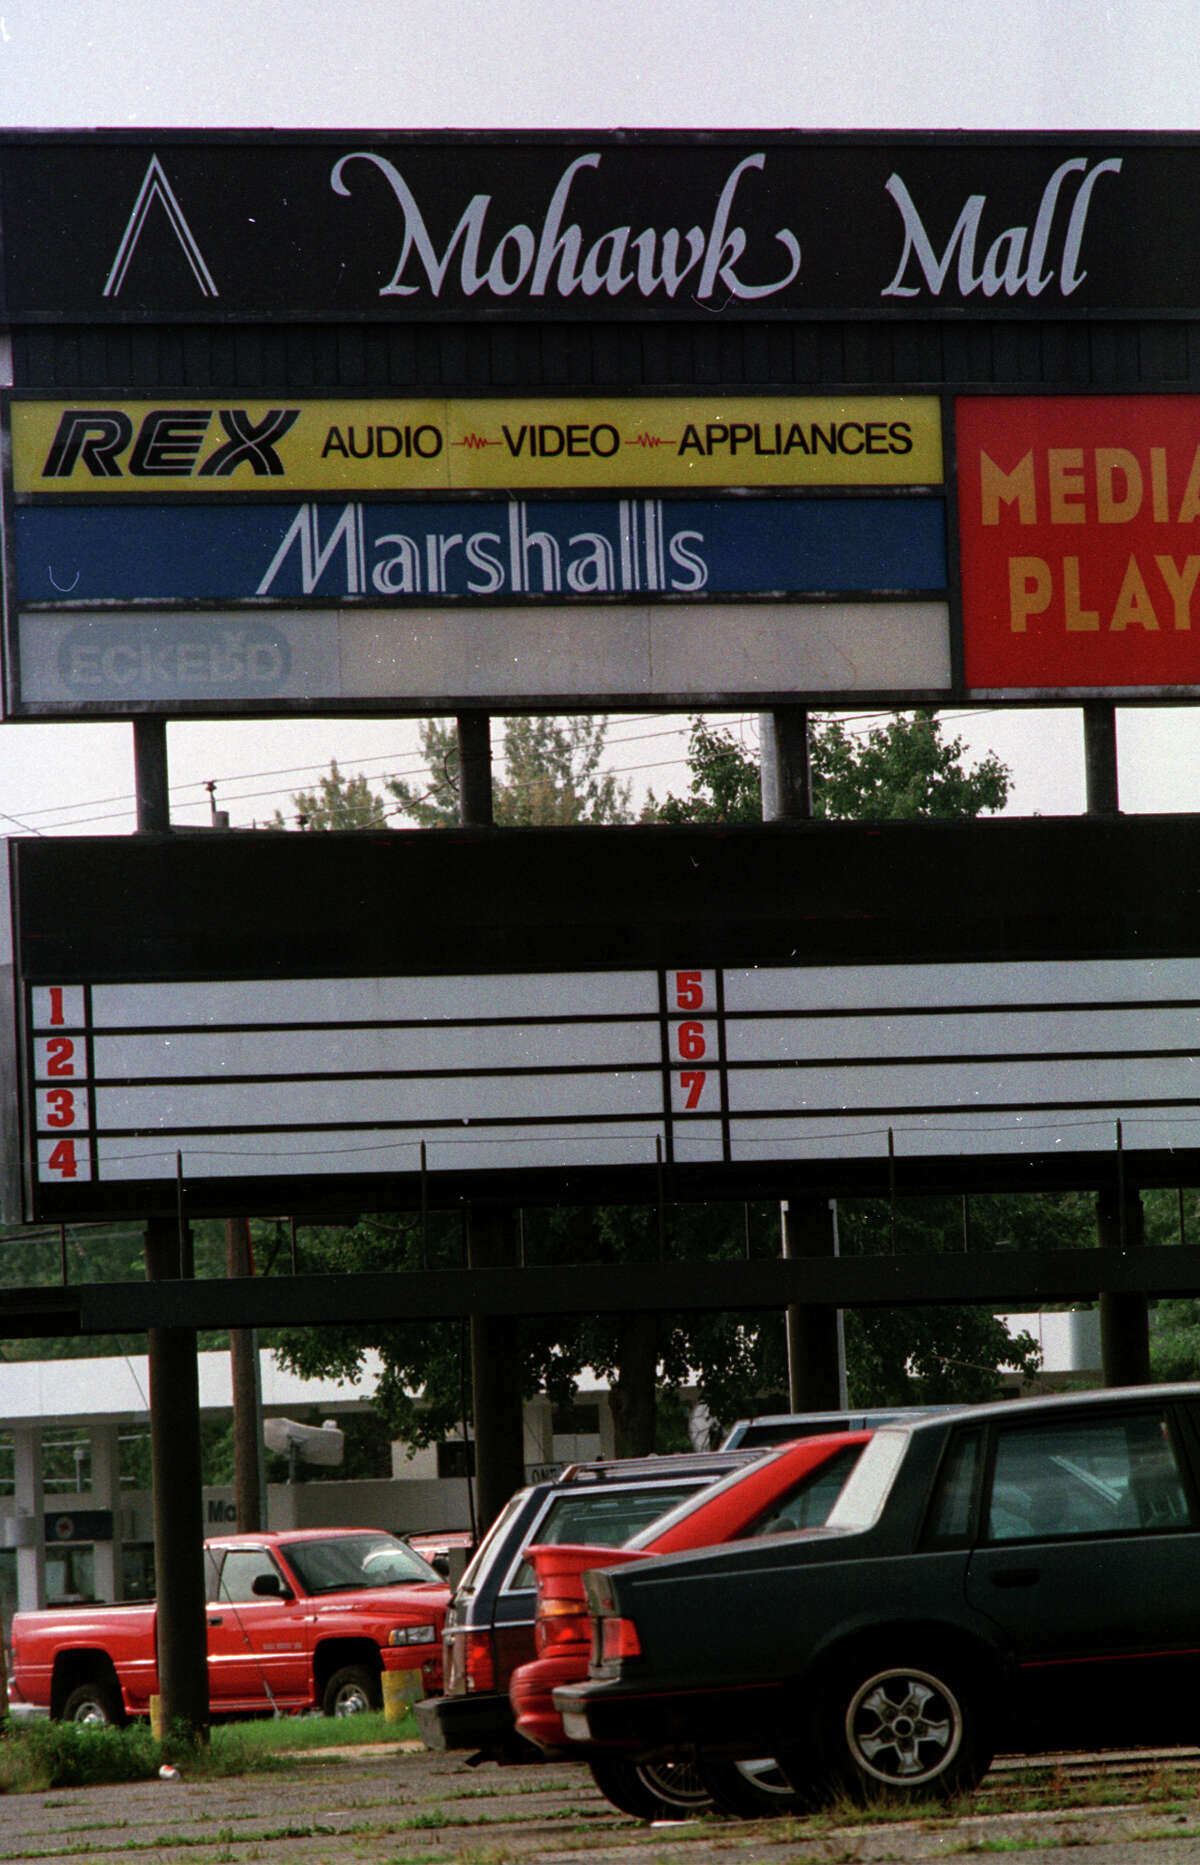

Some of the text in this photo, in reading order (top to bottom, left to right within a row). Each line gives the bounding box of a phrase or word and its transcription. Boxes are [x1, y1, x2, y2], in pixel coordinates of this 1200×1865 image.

[330, 152, 1123, 299] Mohawk Mall
[41, 409, 301, 478] REX
[321, 421, 914, 460] AUDIO VIDEO APPLIANCES
[255, 500, 709, 596] Marshalls
[1007, 552, 1200, 633] PLAY
[49, 987, 64, 1025] 1
[676, 971, 703, 1010] 5
[46, 1038, 74, 1076] 2
[678, 1021, 706, 1060] 6
[46, 1089, 75, 1128] 3
[680, 1071, 706, 1109] 7
[48, 1140, 77, 1177] 4
